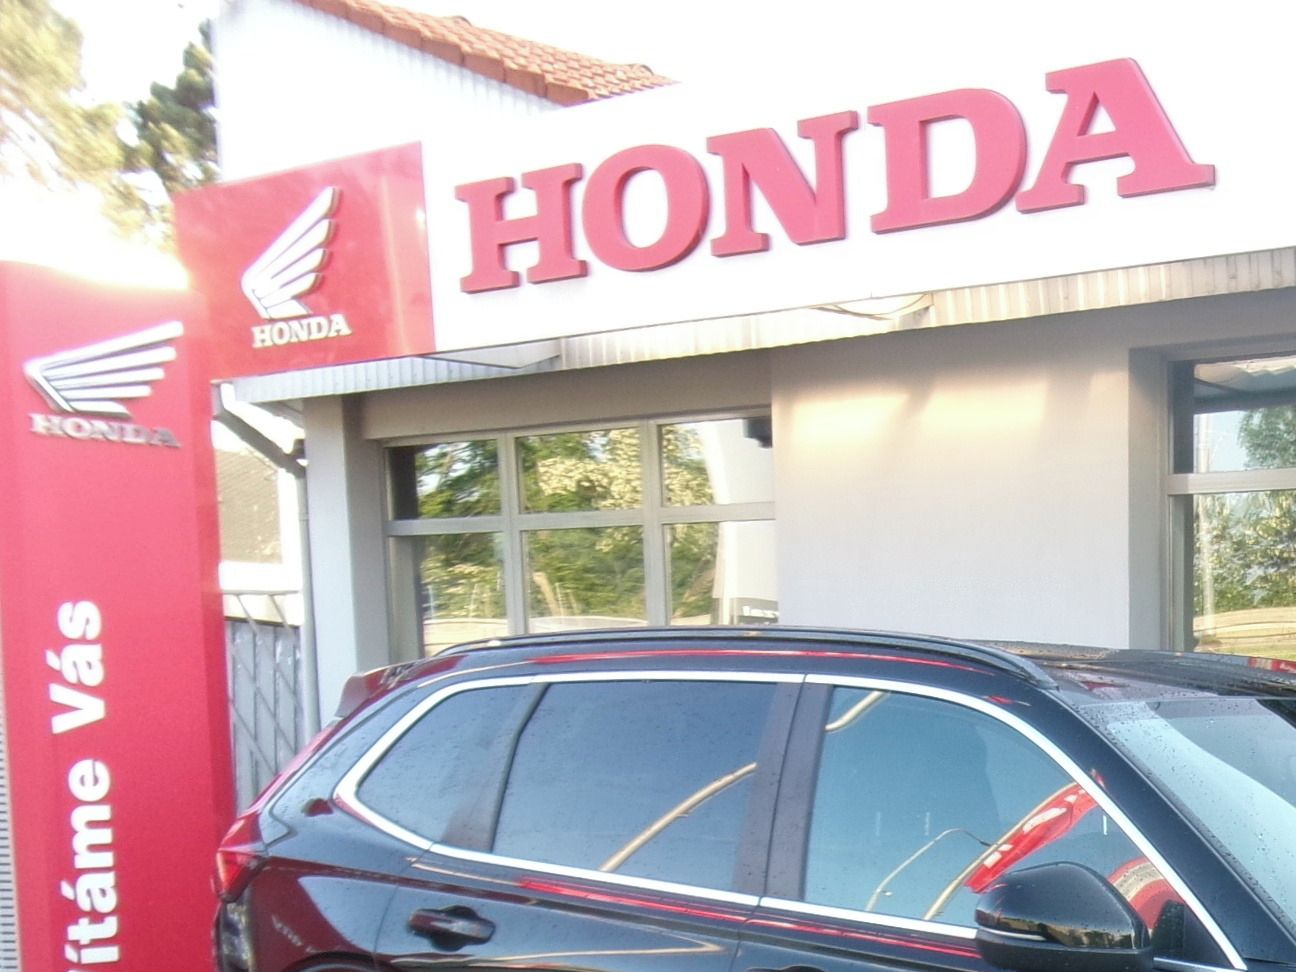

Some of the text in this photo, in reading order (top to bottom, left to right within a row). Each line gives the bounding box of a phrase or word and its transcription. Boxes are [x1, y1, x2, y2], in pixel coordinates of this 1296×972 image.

[454, 56, 1216, 295] HONDA
[252, 313, 352, 349] HONDA
[29, 413, 181, 449] HONDA
[46, 600, 106, 735] Vás
